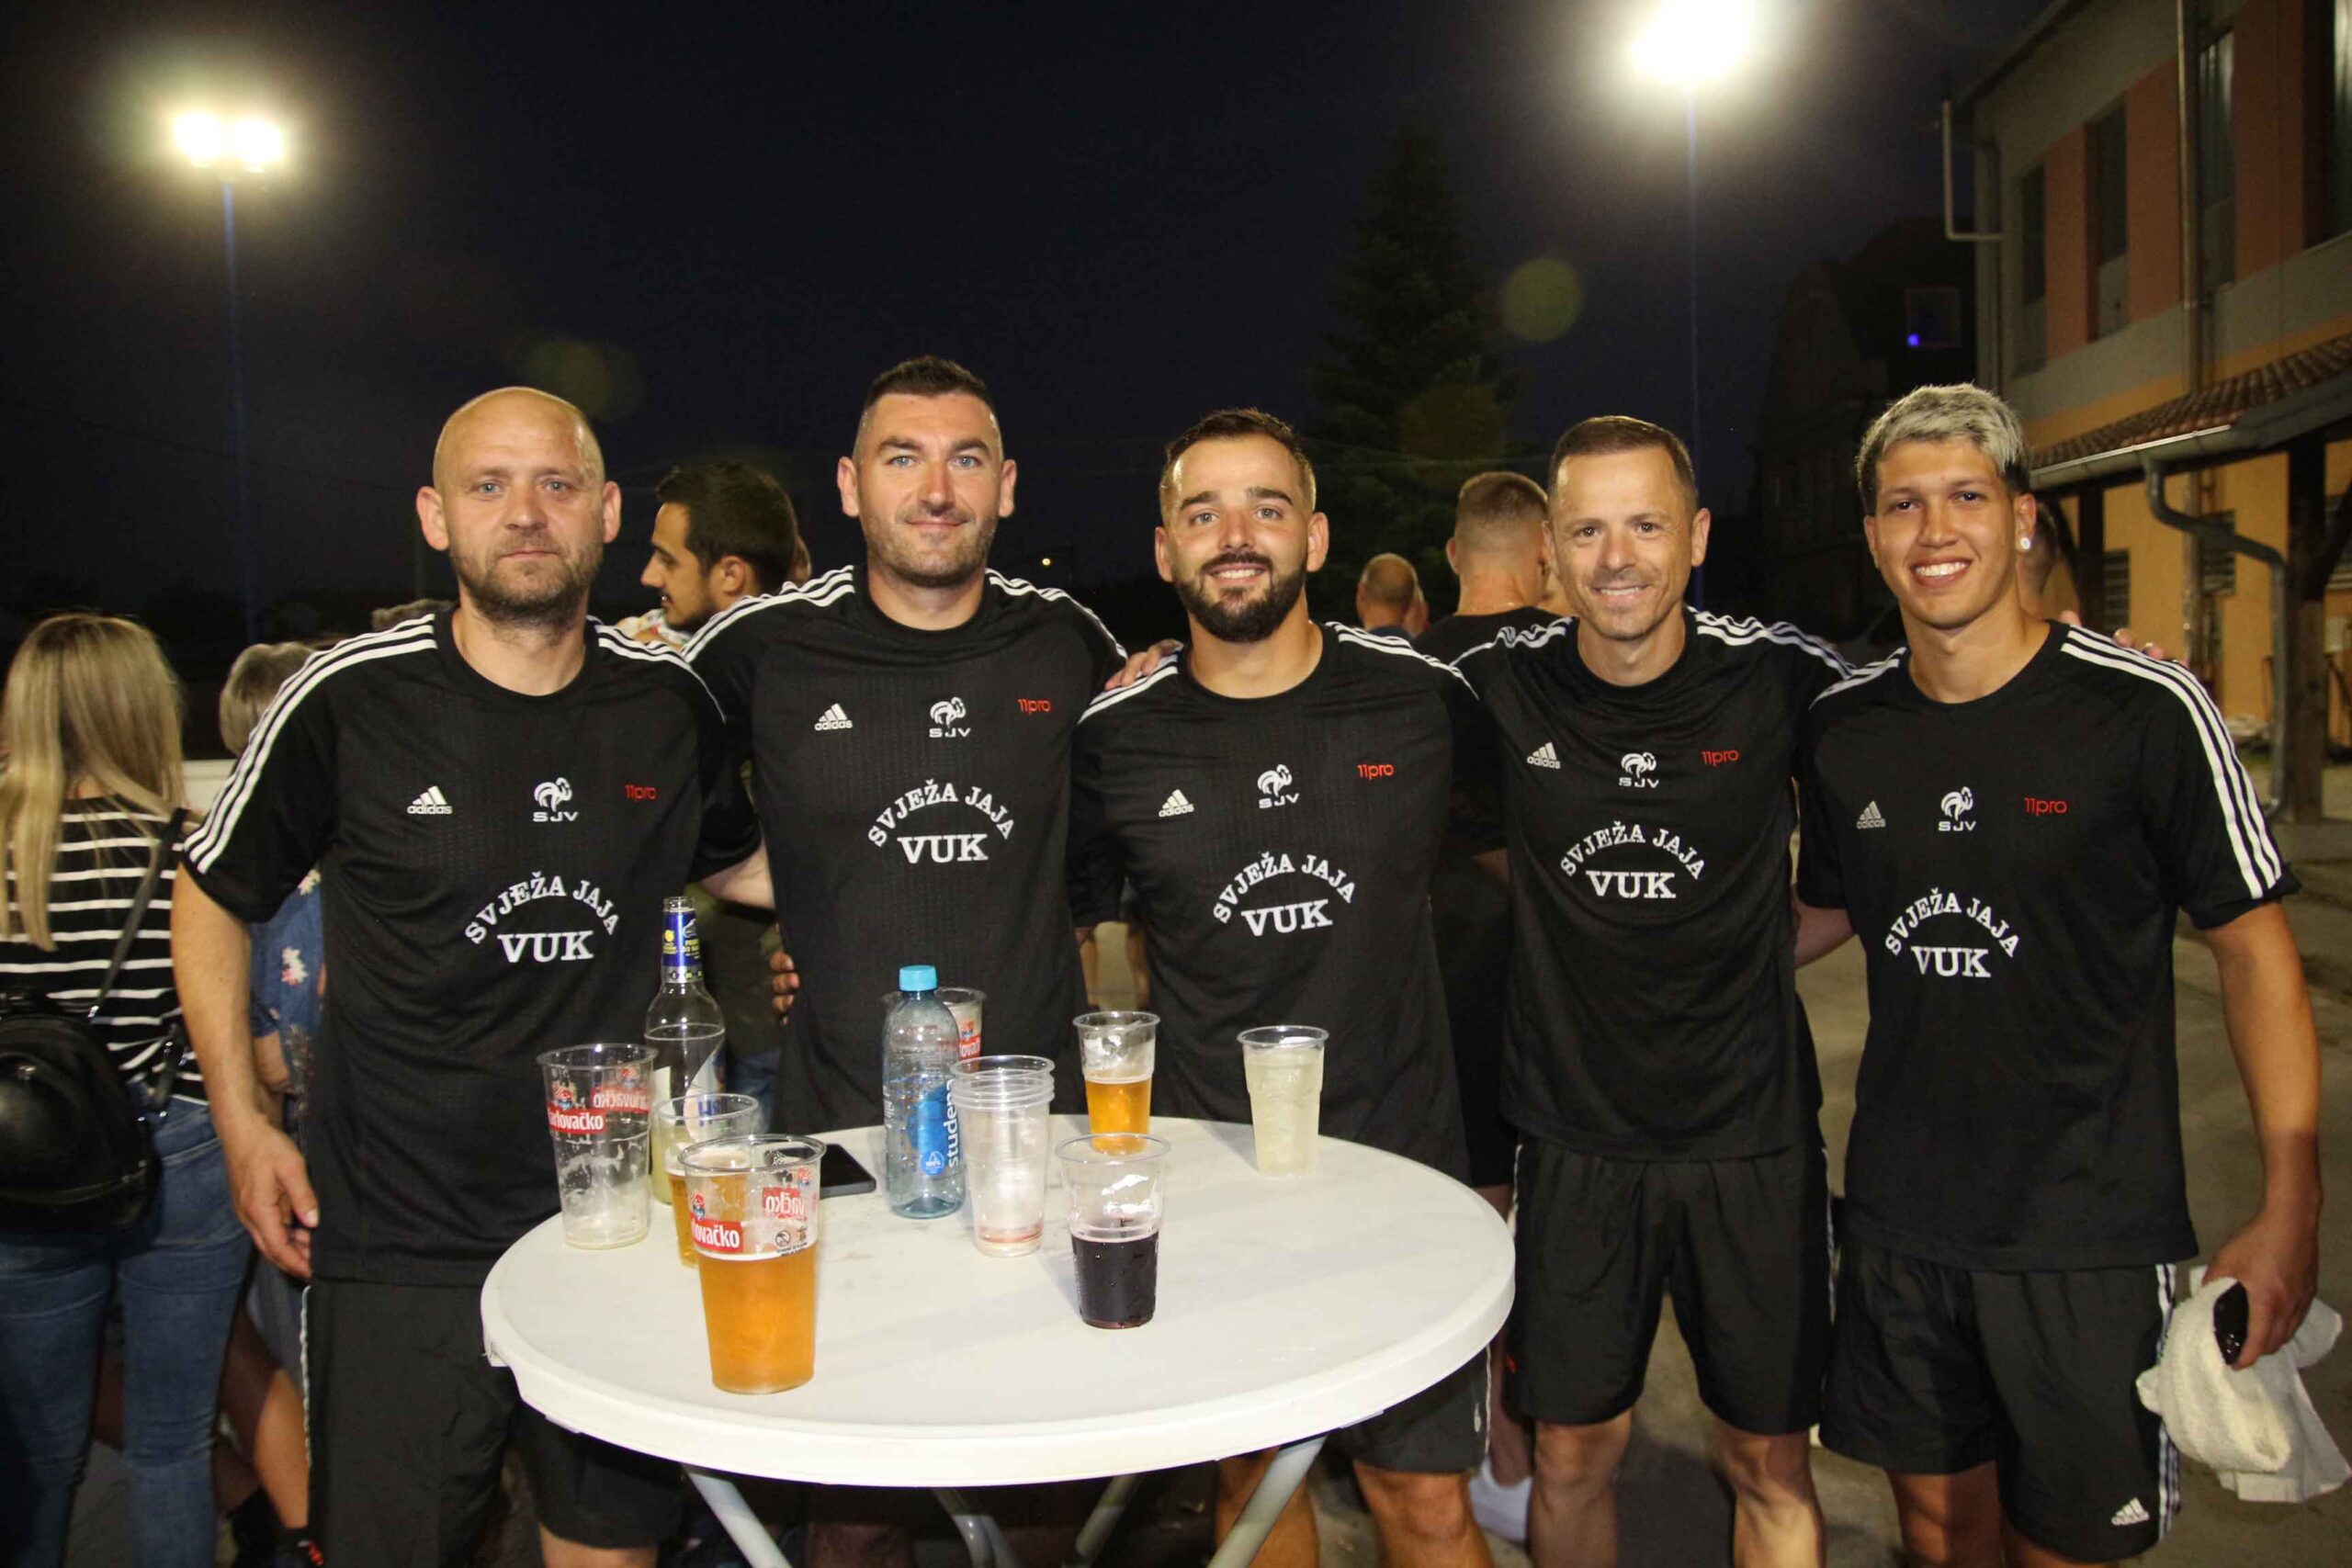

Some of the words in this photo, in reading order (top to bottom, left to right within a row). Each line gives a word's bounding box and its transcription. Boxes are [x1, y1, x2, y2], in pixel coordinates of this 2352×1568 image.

[814, 718, 854, 731] adidas
[928, 725, 971, 739] SJV
[1526, 755, 1561, 770] adidas
[1618, 775, 1659, 789] SJV
[406, 802, 453, 815] adidas
[867, 778, 959, 848] SVJEŽA
[964, 786, 1014, 840] JAJA
[1158, 803, 1195, 818] adidas
[1258, 792, 1300, 809] SJV
[532, 811, 579, 823] SJV
[1938, 820, 1977, 832] SJV
[896, 833, 989, 864] VUK
[1560, 820, 1646, 877] SVJEŽA
[1652, 829, 1705, 880] JAJA
[1213, 851, 1296, 924] SVJEŽA
[1300, 853, 1356, 904] JAJA
[1585, 870, 1677, 899] VUK
[464, 871, 568, 944] SVJEŽA
[571, 879, 619, 935] JAJA
[1240, 898, 1334, 937] VUK
[1884, 886, 1962, 956] SVJEŽA
[1966, 898, 2019, 958] JAJA
[496, 930, 594, 964] VUK
[1910, 945, 1992, 978] VUK
